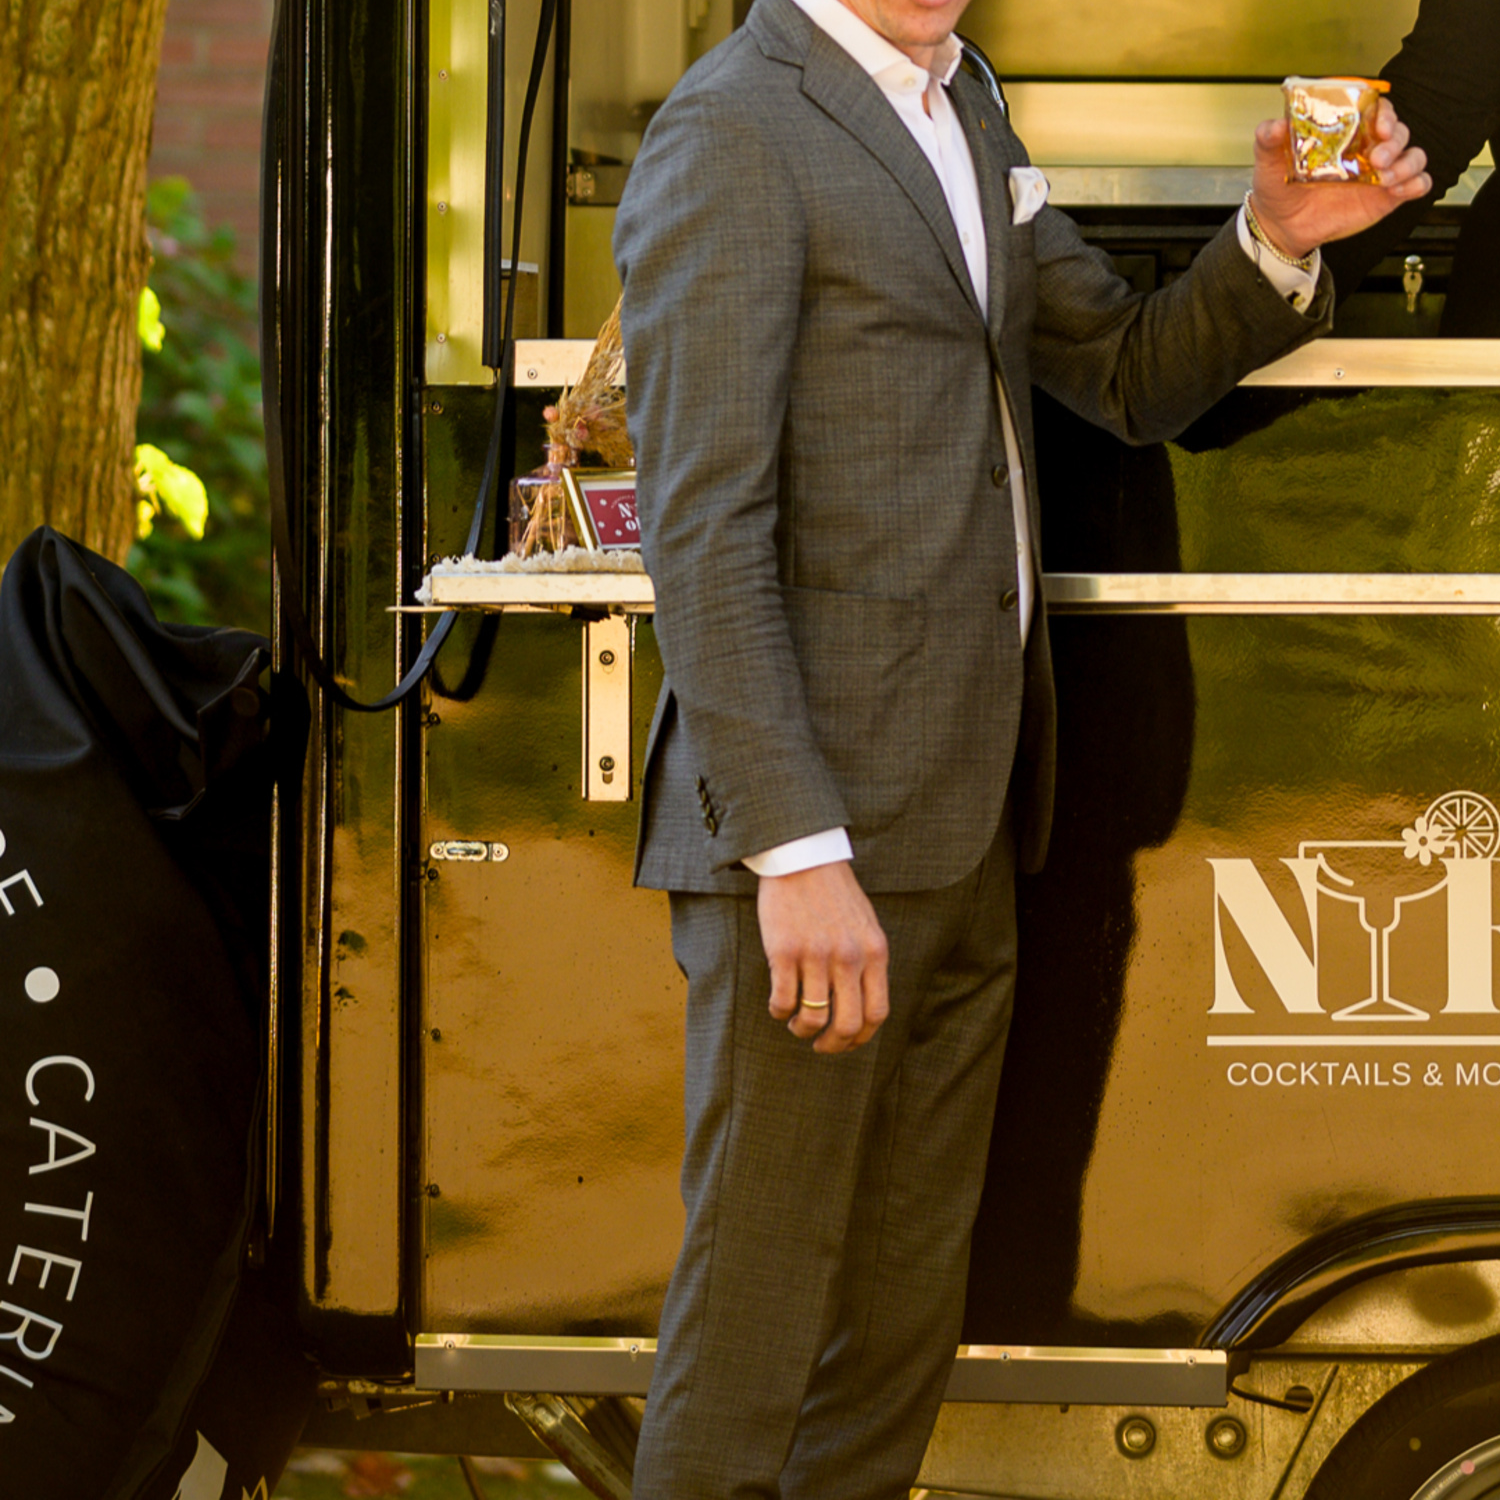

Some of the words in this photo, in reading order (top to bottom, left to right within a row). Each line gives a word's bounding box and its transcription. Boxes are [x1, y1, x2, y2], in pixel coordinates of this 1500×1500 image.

[1226, 1061, 1412, 1087] COCKTAILS
[1422, 1061, 1444, 1087] &
[0, 1054, 96, 1424] CATERI
